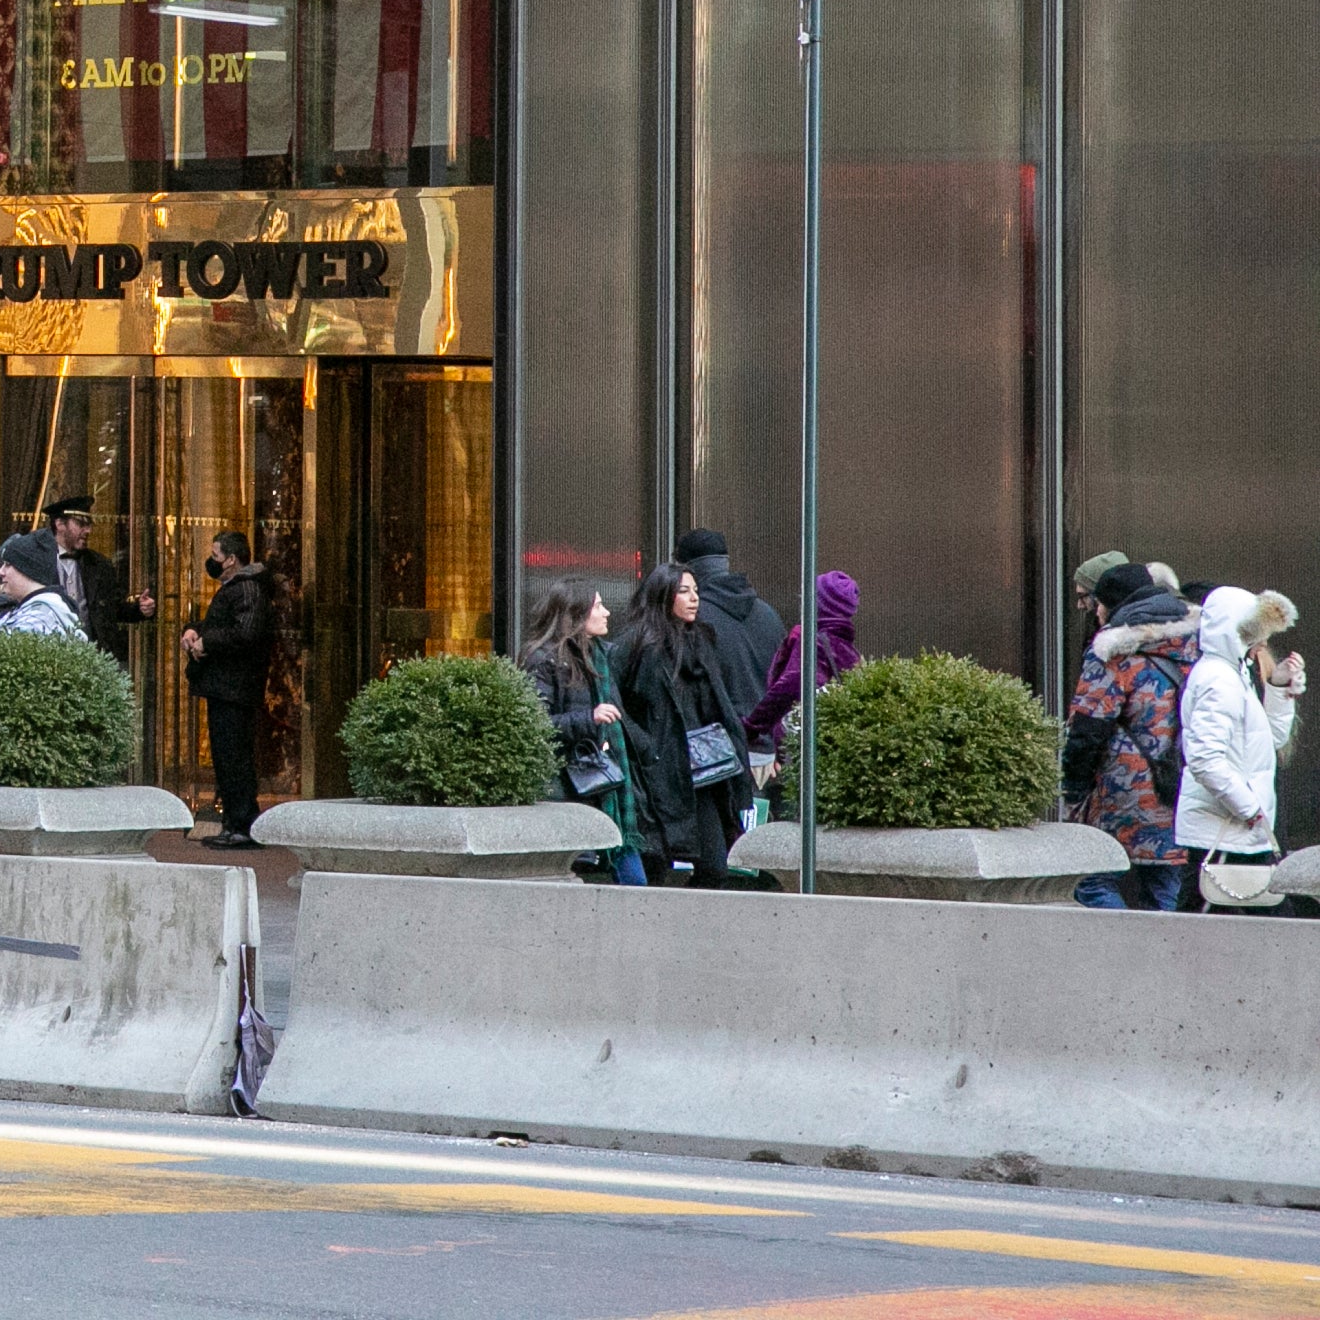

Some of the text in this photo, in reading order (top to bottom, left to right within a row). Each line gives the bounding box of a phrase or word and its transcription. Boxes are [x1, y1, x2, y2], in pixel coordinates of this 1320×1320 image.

[80, 57, 135, 88] AM
[139, 59, 166, 87] to
[208, 52, 252, 85] PM
[148, 239, 391, 300] TOWER
